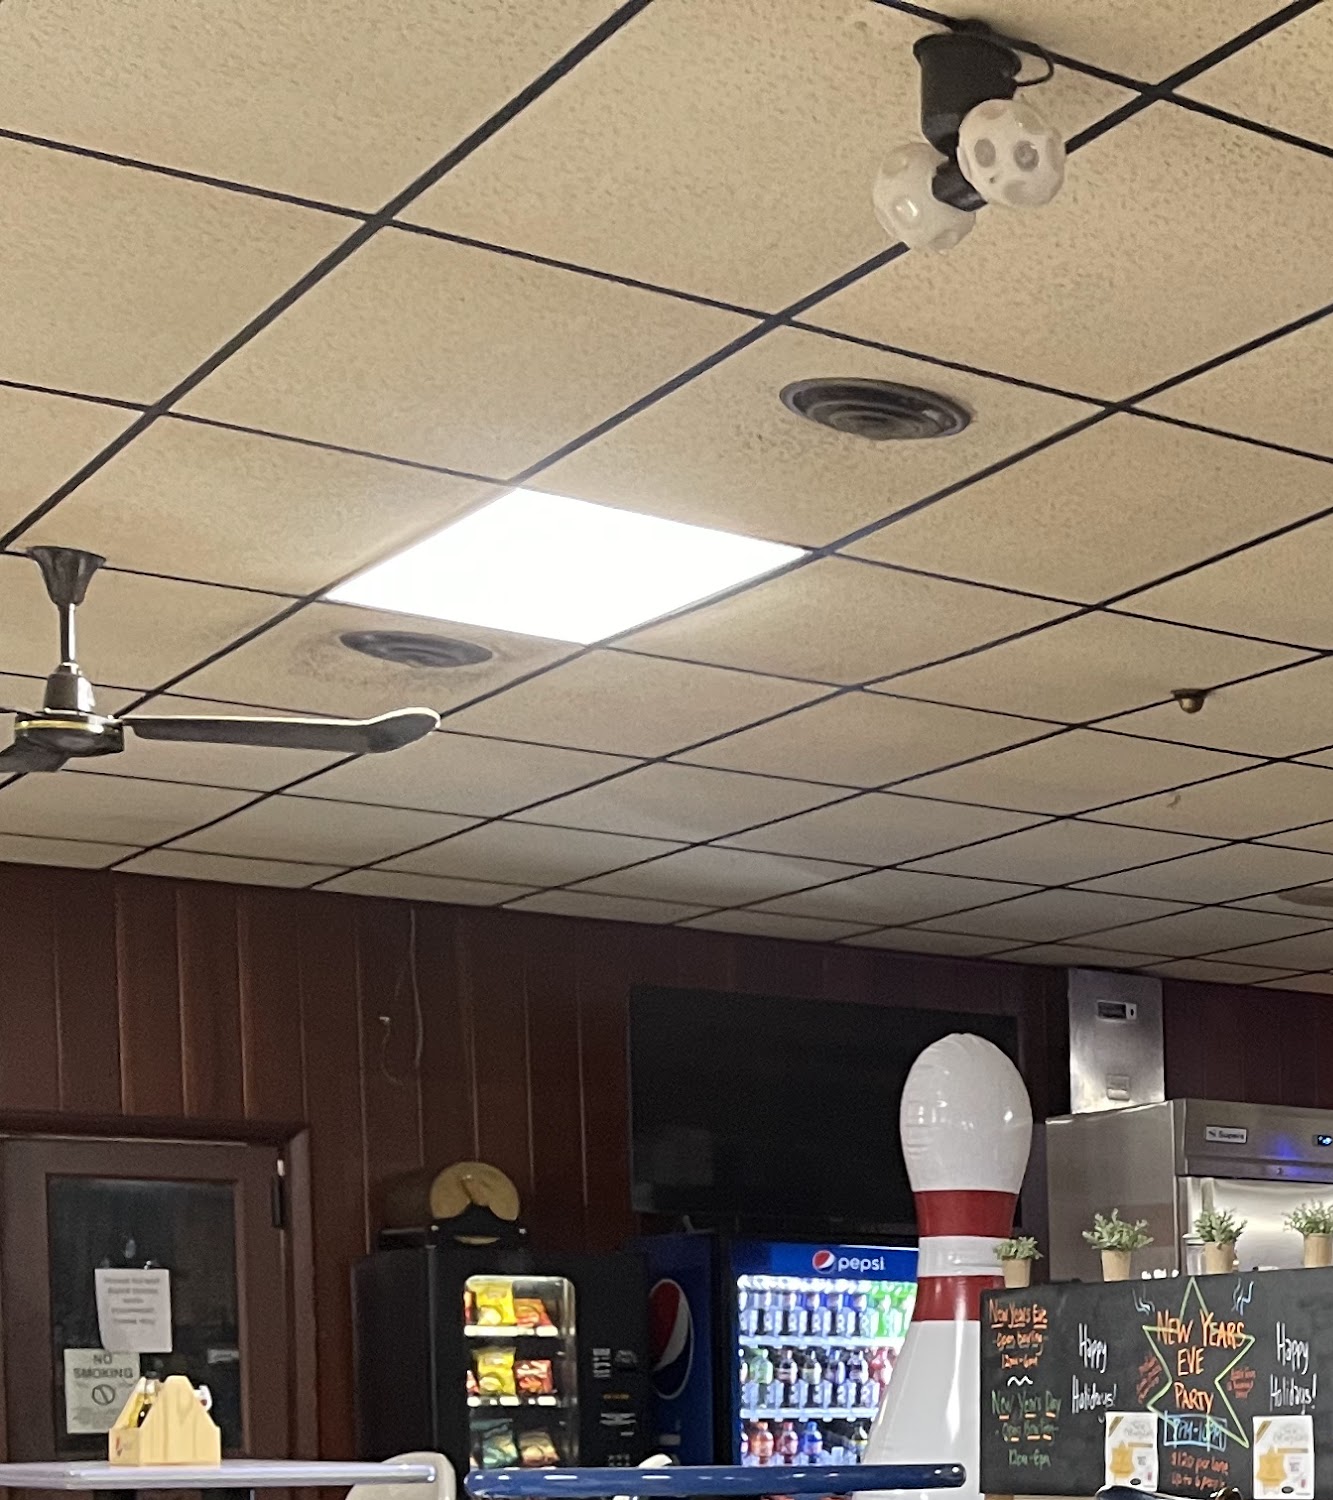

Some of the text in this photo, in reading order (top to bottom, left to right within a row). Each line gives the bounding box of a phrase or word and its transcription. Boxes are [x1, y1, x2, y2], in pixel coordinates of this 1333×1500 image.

[838, 1256, 886, 1272] pepsi
[1157, 1309, 1246, 1350] NEW YEARS
[1276, 1320, 1310, 1375] Happy
[93, 1352, 113, 1365] NO
[1078, 1322, 1108, 1374] Happy
[1177, 1346, 1205, 1377] EVE
[73, 1367, 134, 1379] SMOKING
[1071, 1374, 1118, 1423] Holidays!
[1173, 1382, 1215, 1414] PARTY
[1269, 1372, 1317, 1415] Holidays!
